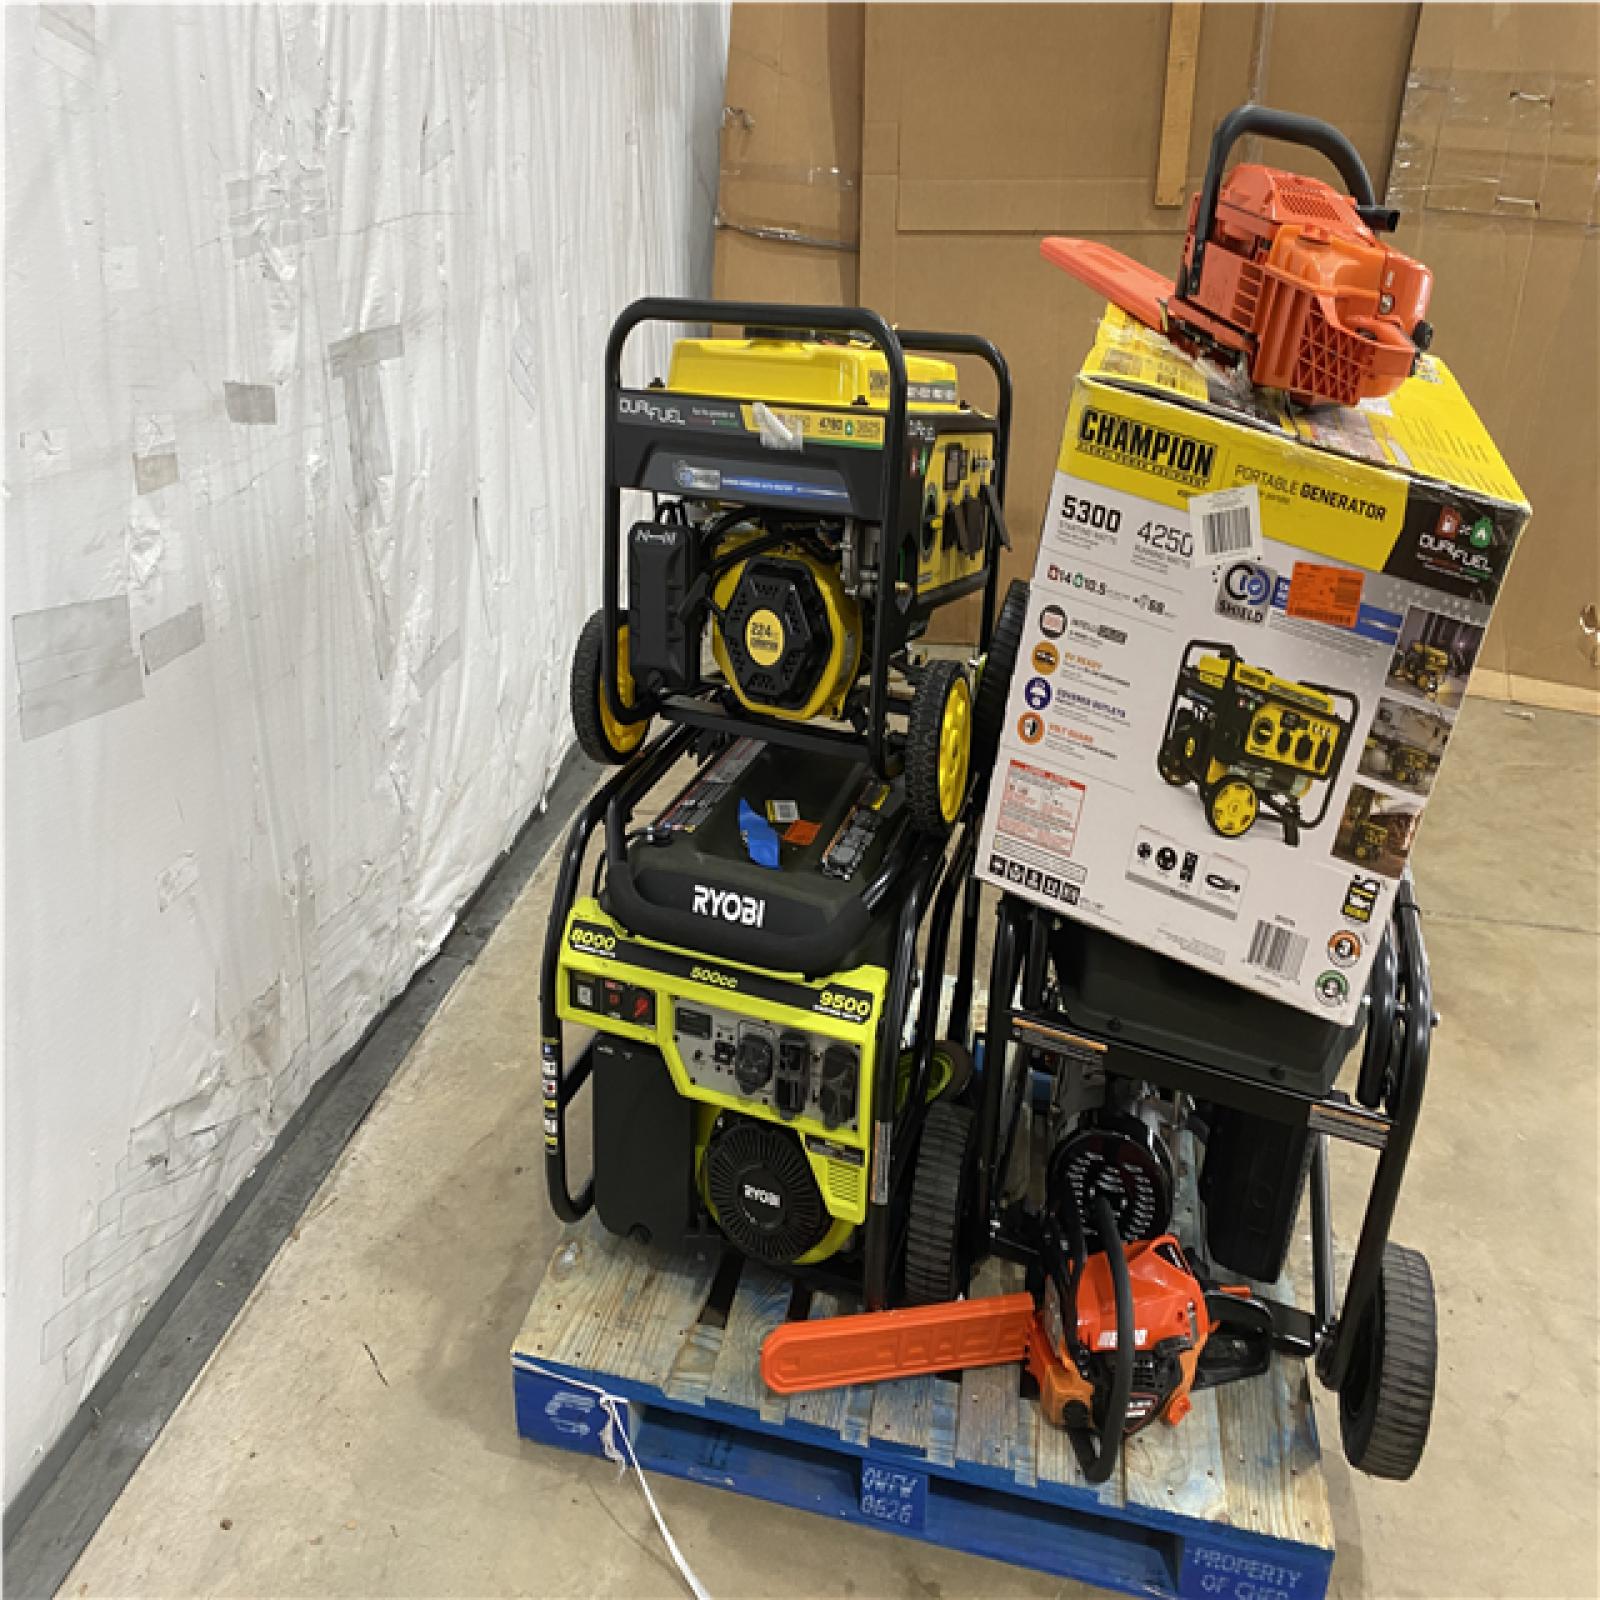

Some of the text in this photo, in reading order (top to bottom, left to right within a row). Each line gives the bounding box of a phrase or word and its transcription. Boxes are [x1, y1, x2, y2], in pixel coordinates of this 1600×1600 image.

[1079, 407, 1214, 477] CHAMPION
[1061, 494, 1121, 533] 5300
[1234, 464, 1299, 496] PORTABLE
[1300, 481, 1388, 522] GENERATOR
[1136, 521, 1193, 557] 4250
[691, 884, 766, 929] RYOBI
[819, 989, 871, 1017] 9500
[744, 1184, 781, 1209] RYOBI
[1193, 1546, 1303, 1589] PROPERTY
